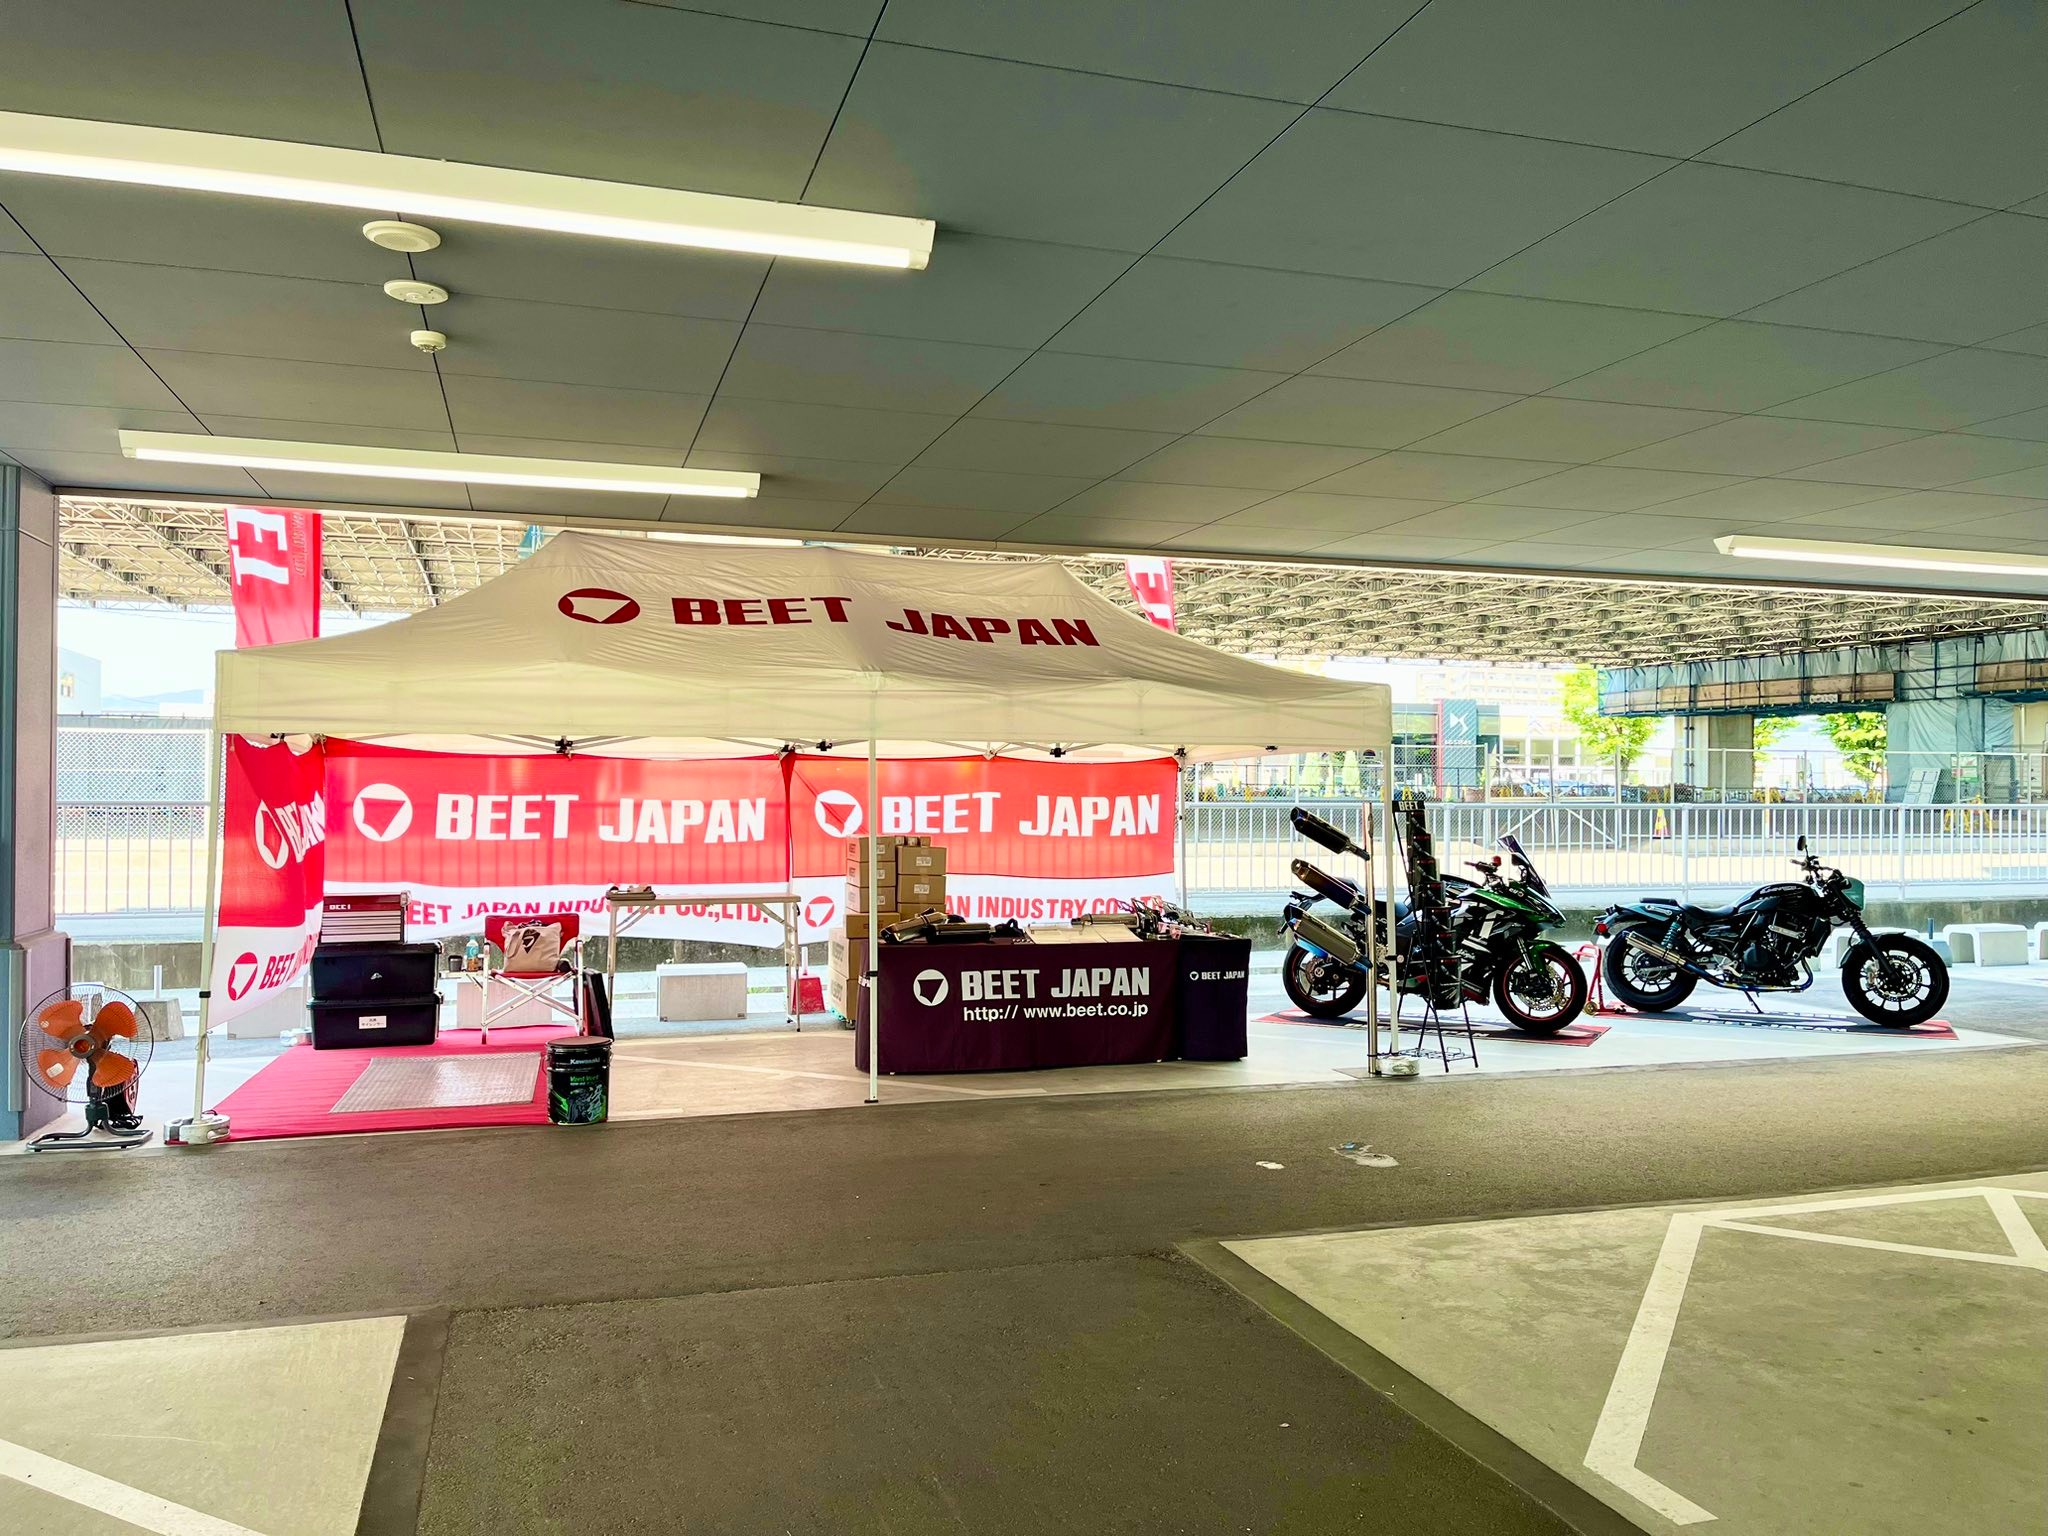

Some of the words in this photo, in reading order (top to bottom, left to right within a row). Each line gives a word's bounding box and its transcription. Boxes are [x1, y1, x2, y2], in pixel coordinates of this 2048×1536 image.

[672, 597, 852, 625] BEET
[886, 608, 1100, 647] JAPAN
[435, 793, 579, 841] BEET
[598, 797, 767, 844] JAPAN
[881, 791, 1001, 834] BEET
[1018, 794, 1160, 837] JAPAN
[1399, 801, 1419, 811] BEET
[404, 900, 452, 925] EET
[461, 901, 541, 919] JAPAN
[977, 896, 1087, 919] INDUSTRY
[961, 968, 1040, 1000] BEET
[1050, 966, 1150, 998] JAPAN
[1201, 971, 1221, 980] BEET
[1223, 970, 1245, 979] JAPAN
[963, 1004, 1018, 1022] http://
[1023, 1001, 1149, 1018] www.beet.co.jp
